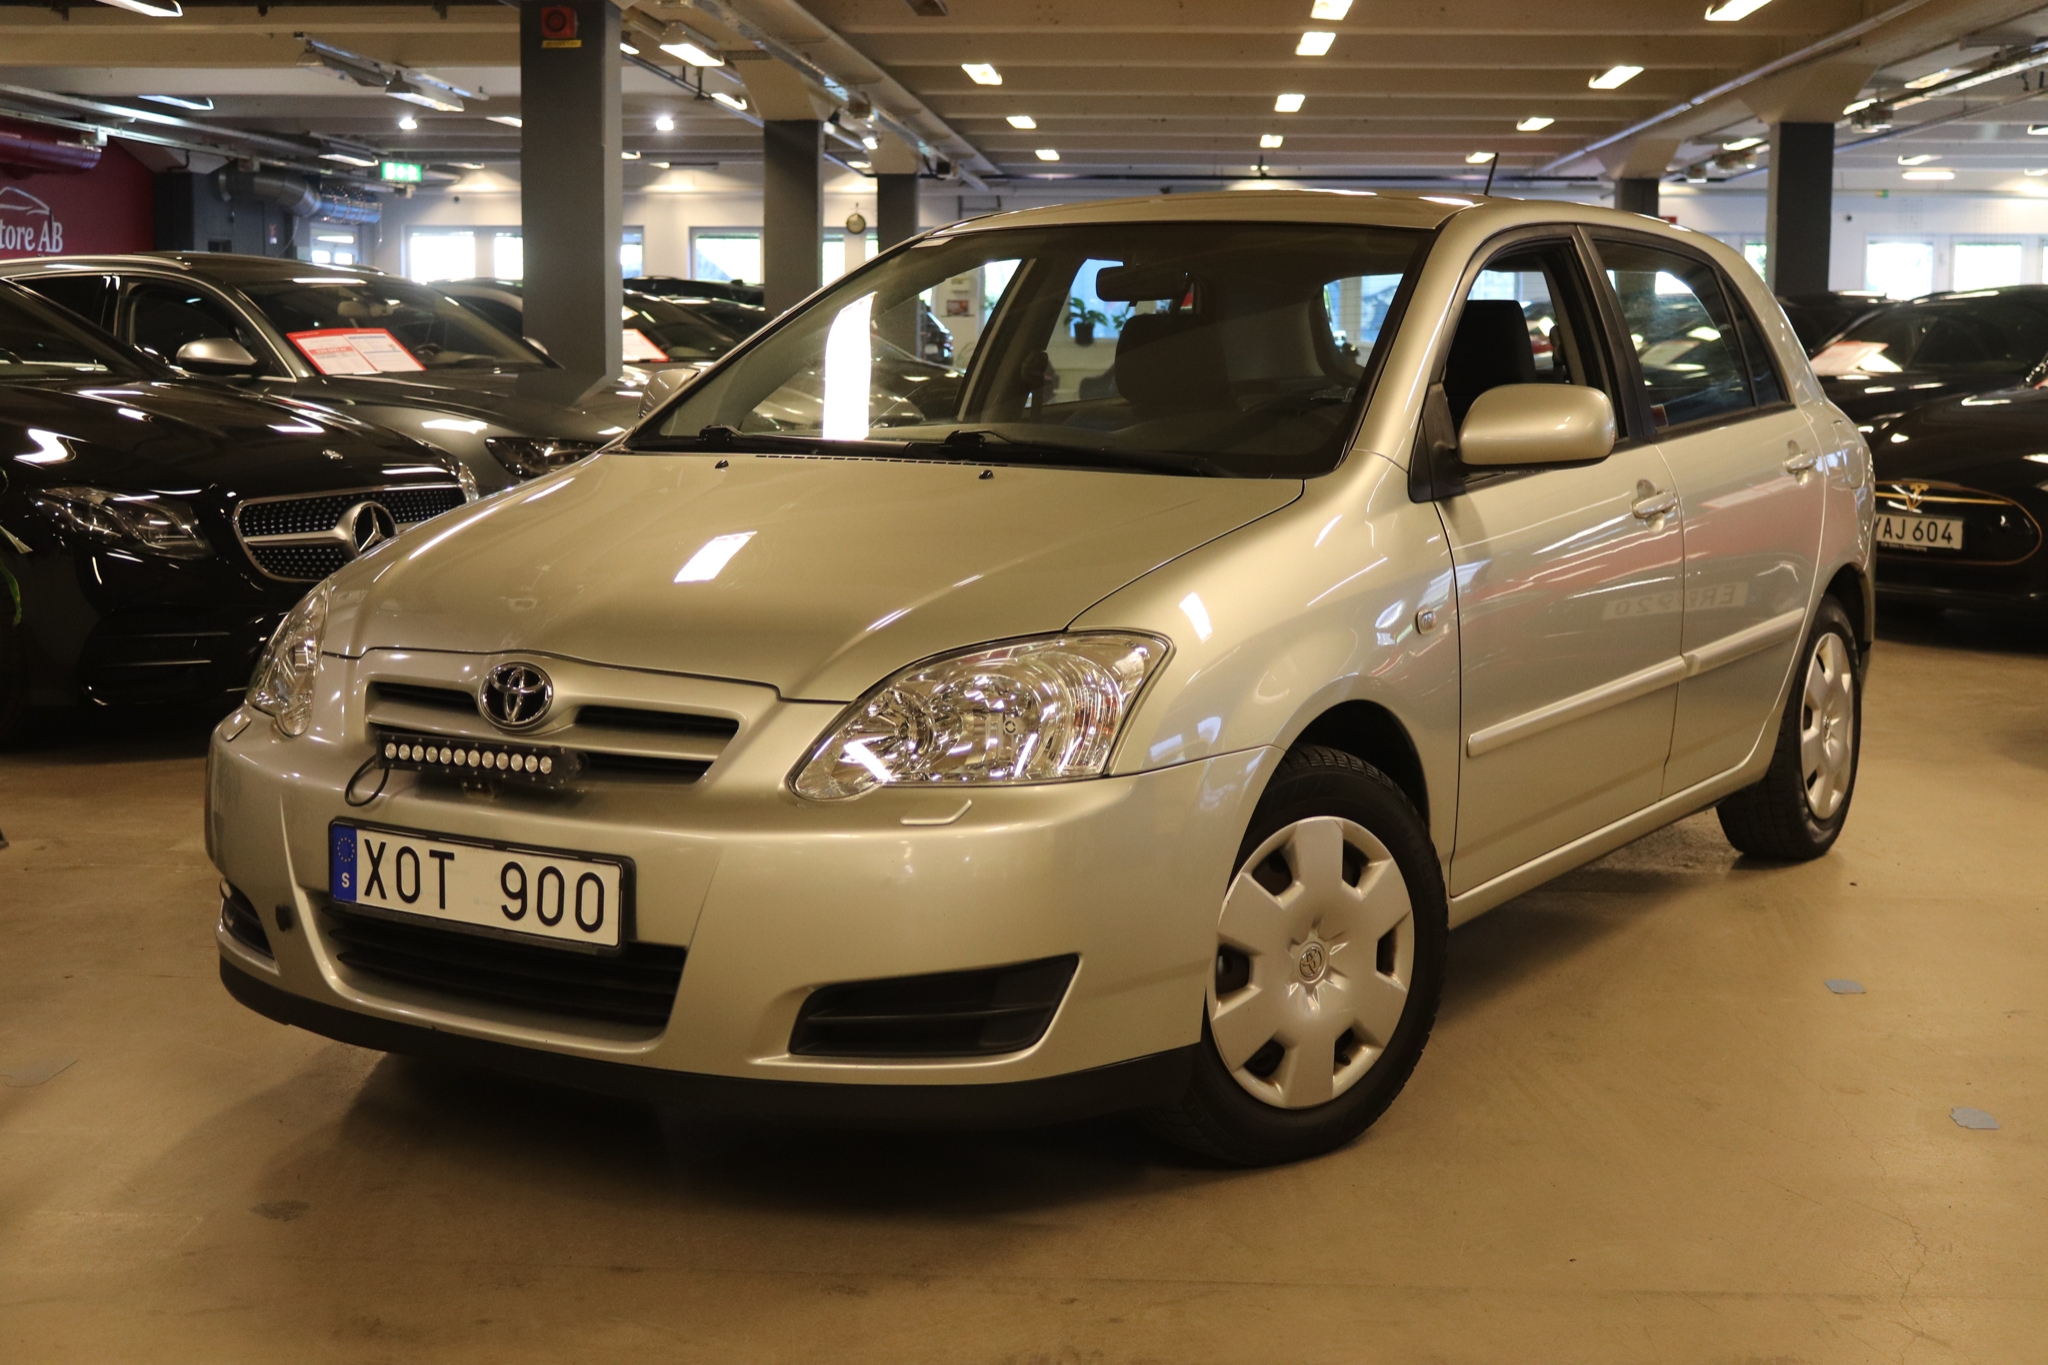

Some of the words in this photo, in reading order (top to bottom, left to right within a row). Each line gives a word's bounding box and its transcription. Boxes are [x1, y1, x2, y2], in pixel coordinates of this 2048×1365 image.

[37, 220, 64, 254] AB
[1911, 520, 1953, 544] 604
[341, 871, 350, 888] S
[364, 838, 455, 910] XOT
[500, 860, 605, 933] 900
